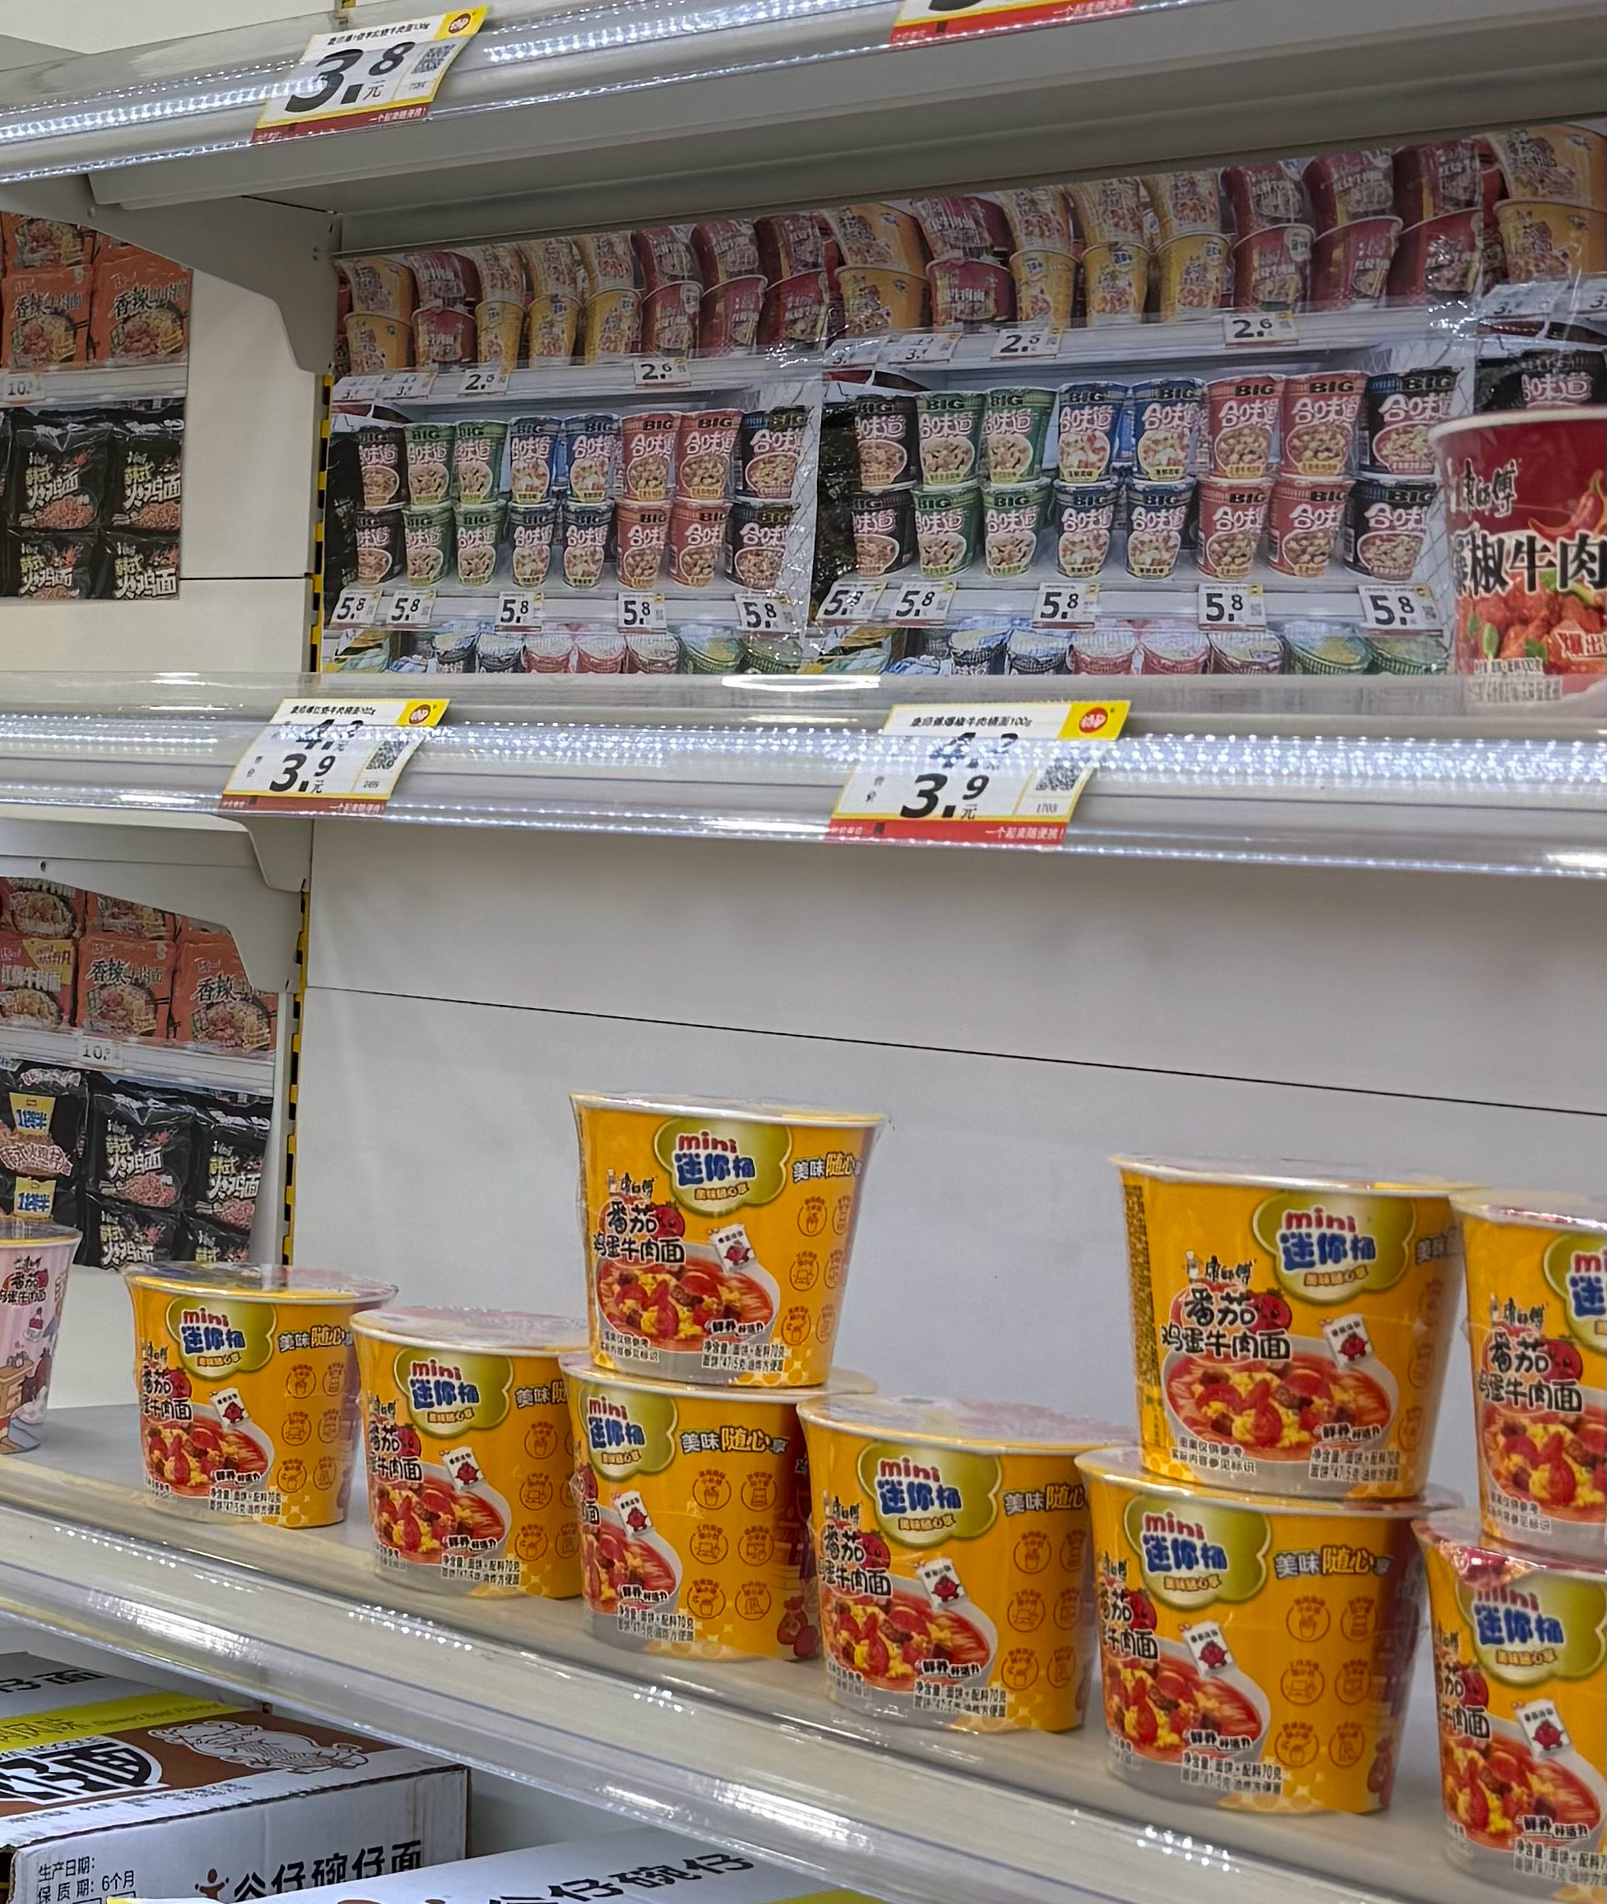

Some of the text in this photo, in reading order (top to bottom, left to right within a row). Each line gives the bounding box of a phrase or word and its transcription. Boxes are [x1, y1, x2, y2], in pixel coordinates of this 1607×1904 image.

[284, 41, 416, 113] 3.8 元
[1233, 317, 1273, 340] 2.6
[1235, 383, 1276, 398] BIG
[1309, 380, 1354, 395] BIG
[926, 399, 965, 412] BIG
[698, 416, 732, 429] BIG
[391, 598, 420, 620] 5.8
[500, 600, 530, 623] 5.8
[624, 600, 652, 624] 5.8
[896, 592, 934, 617] 5.8
[1040, 594, 1079, 619] 5.8
[1206, 597, 1244, 622] 5.8
[1370, 595, 1415, 624] 5.8
[269, 753, 336, 793] 3.9
[900, 772, 990, 820] 3.9 元
[678, 1130, 738, 1154] mini
[606, 1199, 659, 1235] 番茄
[1285, 1209, 1357, 1233] mini
[183, 1306, 230, 1328] mini
[1184, 1292, 1256, 1328] 番茄
[1161, 1326, 1291, 1362] 鸡蛋牛肉面
[1491, 1334, 1551, 1374] 番茄
[412, 1358, 462, 1381] mini
[588, 1395, 629, 1420] mini
[879, 1457, 941, 1480] mini
[1143, 1512, 1207, 1539] mini
[39, 1856, 97, 1884] 生产日期：
[102, 1869, 136, 1894] 6个月
[235, 1840, 423, 1904] 公仔碗仔面
